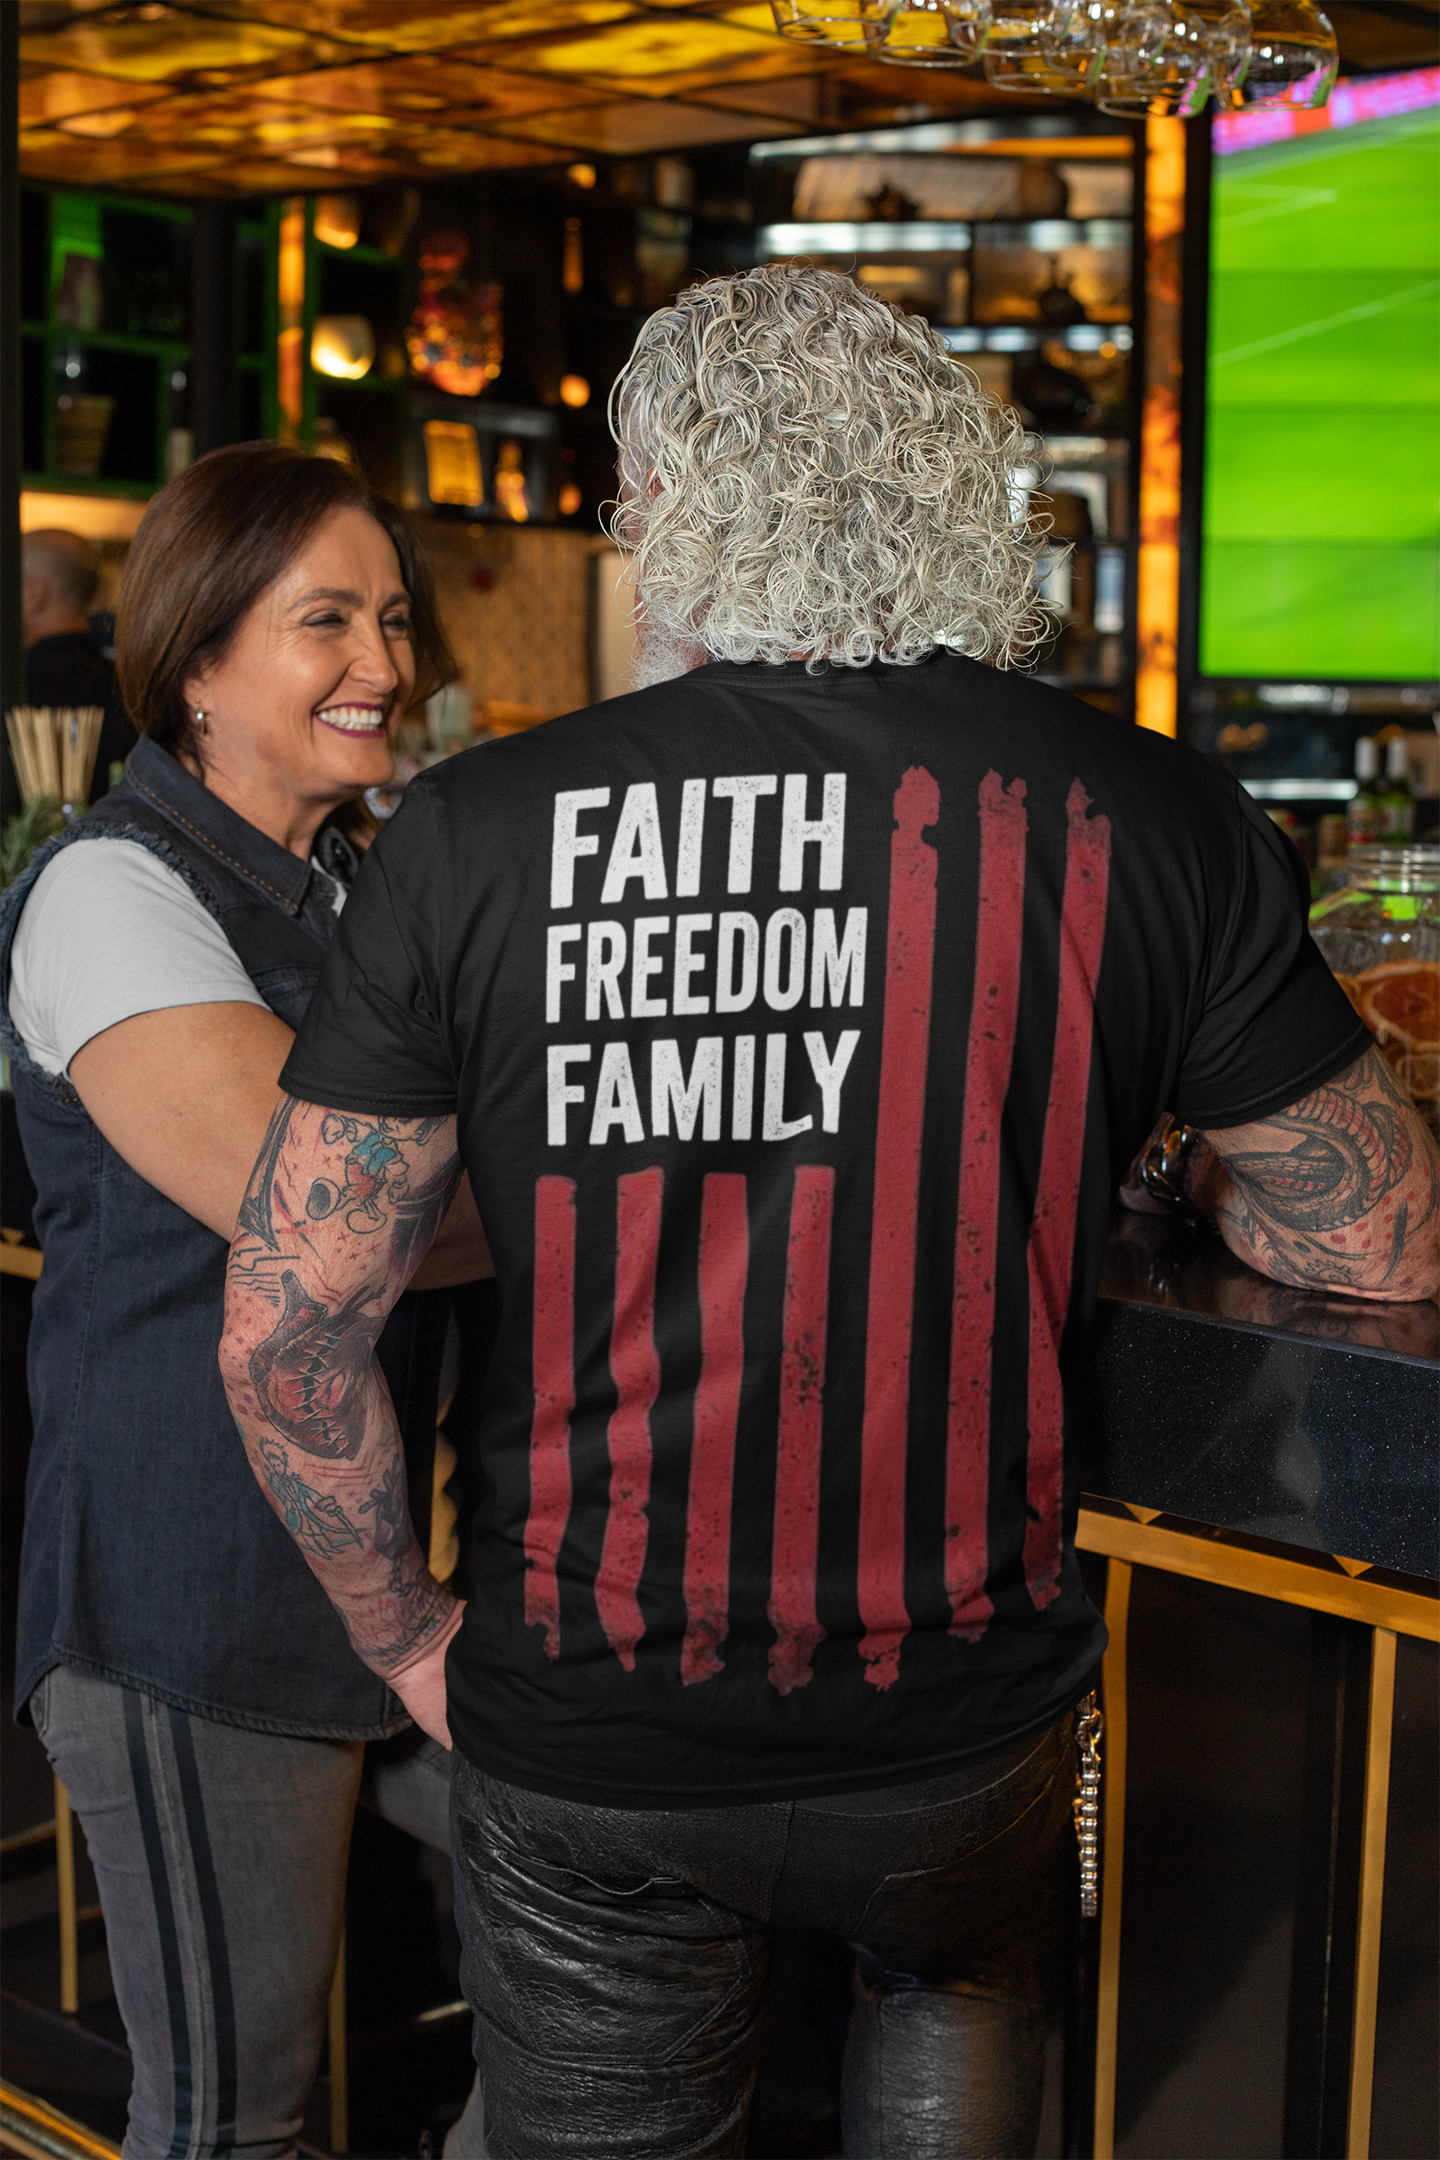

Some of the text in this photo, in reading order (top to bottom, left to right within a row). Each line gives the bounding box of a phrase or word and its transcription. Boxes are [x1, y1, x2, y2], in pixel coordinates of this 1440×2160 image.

[550, 773, 846, 908] FAITH
[546, 907, 868, 1023] FREEDOM
[547, 1030, 861, 1145] FAMILY
